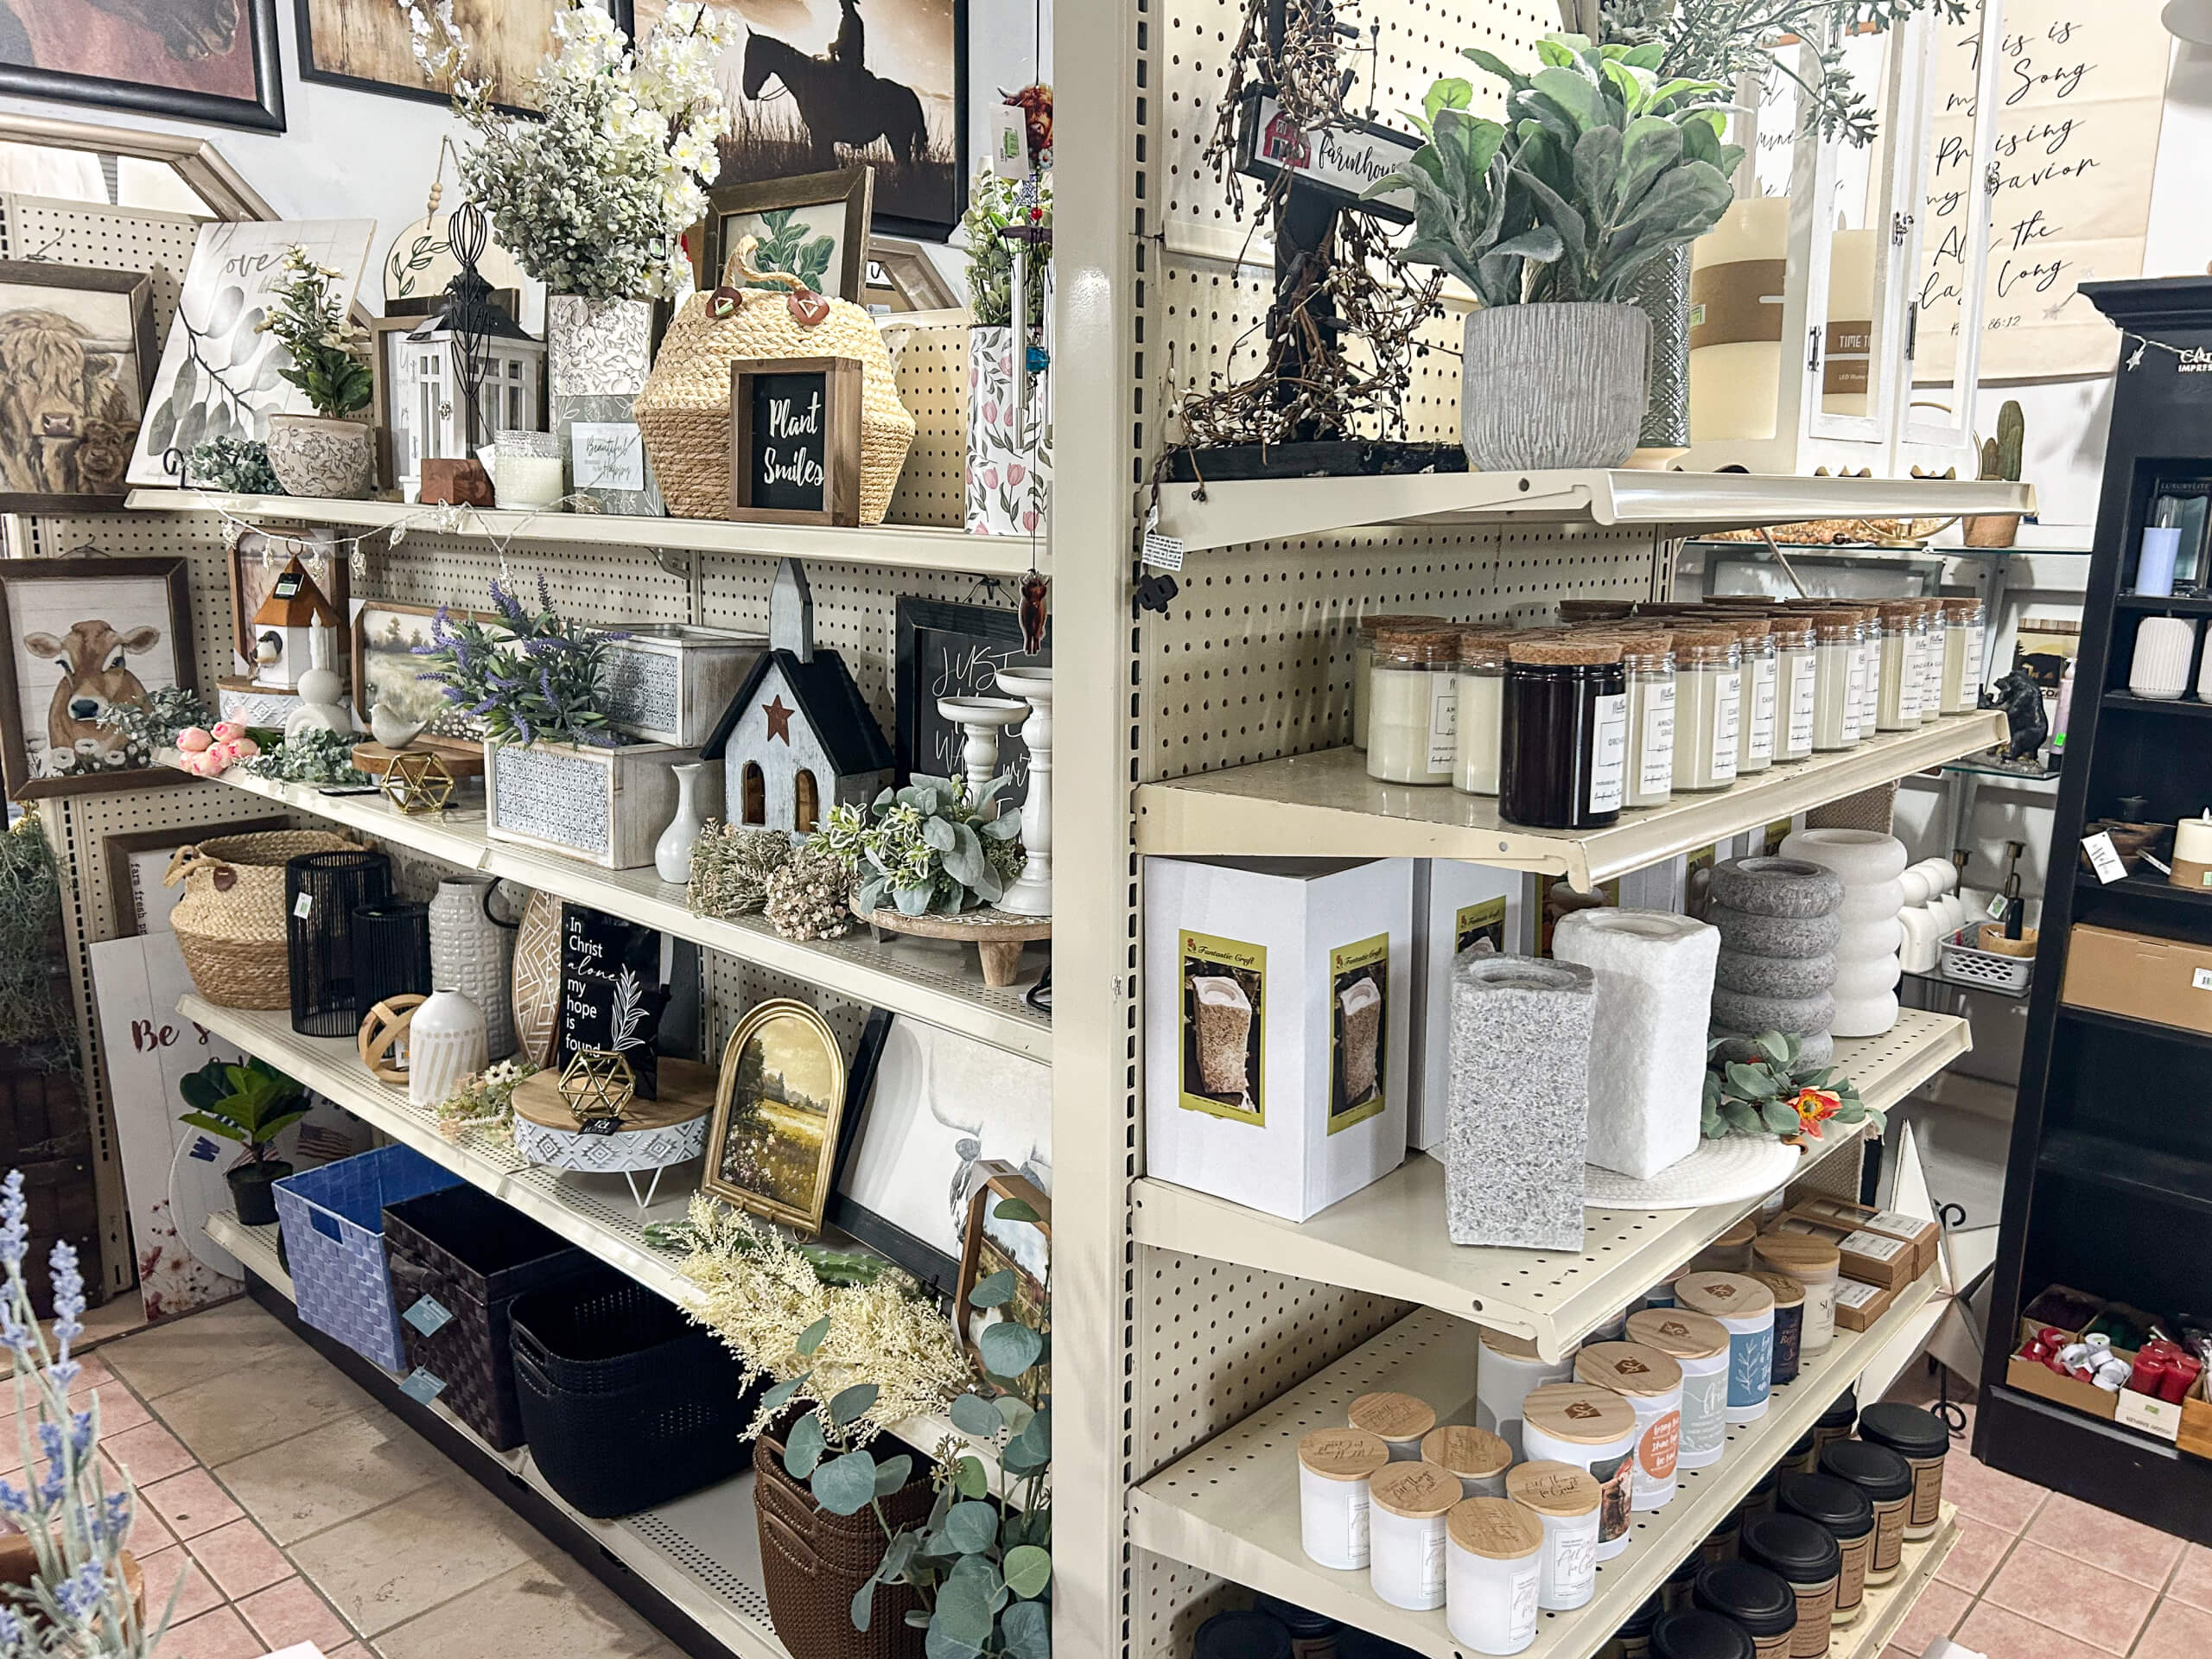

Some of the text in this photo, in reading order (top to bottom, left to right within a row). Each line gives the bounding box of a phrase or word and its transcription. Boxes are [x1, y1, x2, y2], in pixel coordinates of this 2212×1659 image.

[1957, 21, 2083, 71] Tis is
[2005, 58, 2098, 105] Song
[1319, 136, 1396, 182] farmhou
[1936, 118, 2086, 176] Prising
[1839, 334, 1861, 348] TIME
[769, 391, 822, 439] Plant
[764, 446, 824, 486] Smiles
[134, 891, 147, 919] fresh
[569, 917, 582, 933] In
[569, 935, 603, 958] Christ
[1198, 945, 1233, 960] Fantastic
[568, 955, 619, 982] alone
[567, 978, 587, 998] my
[567, 994, 597, 1020] hope
[566, 1013, 575, 1030] is
[131, 1019, 180, 1052] Be
